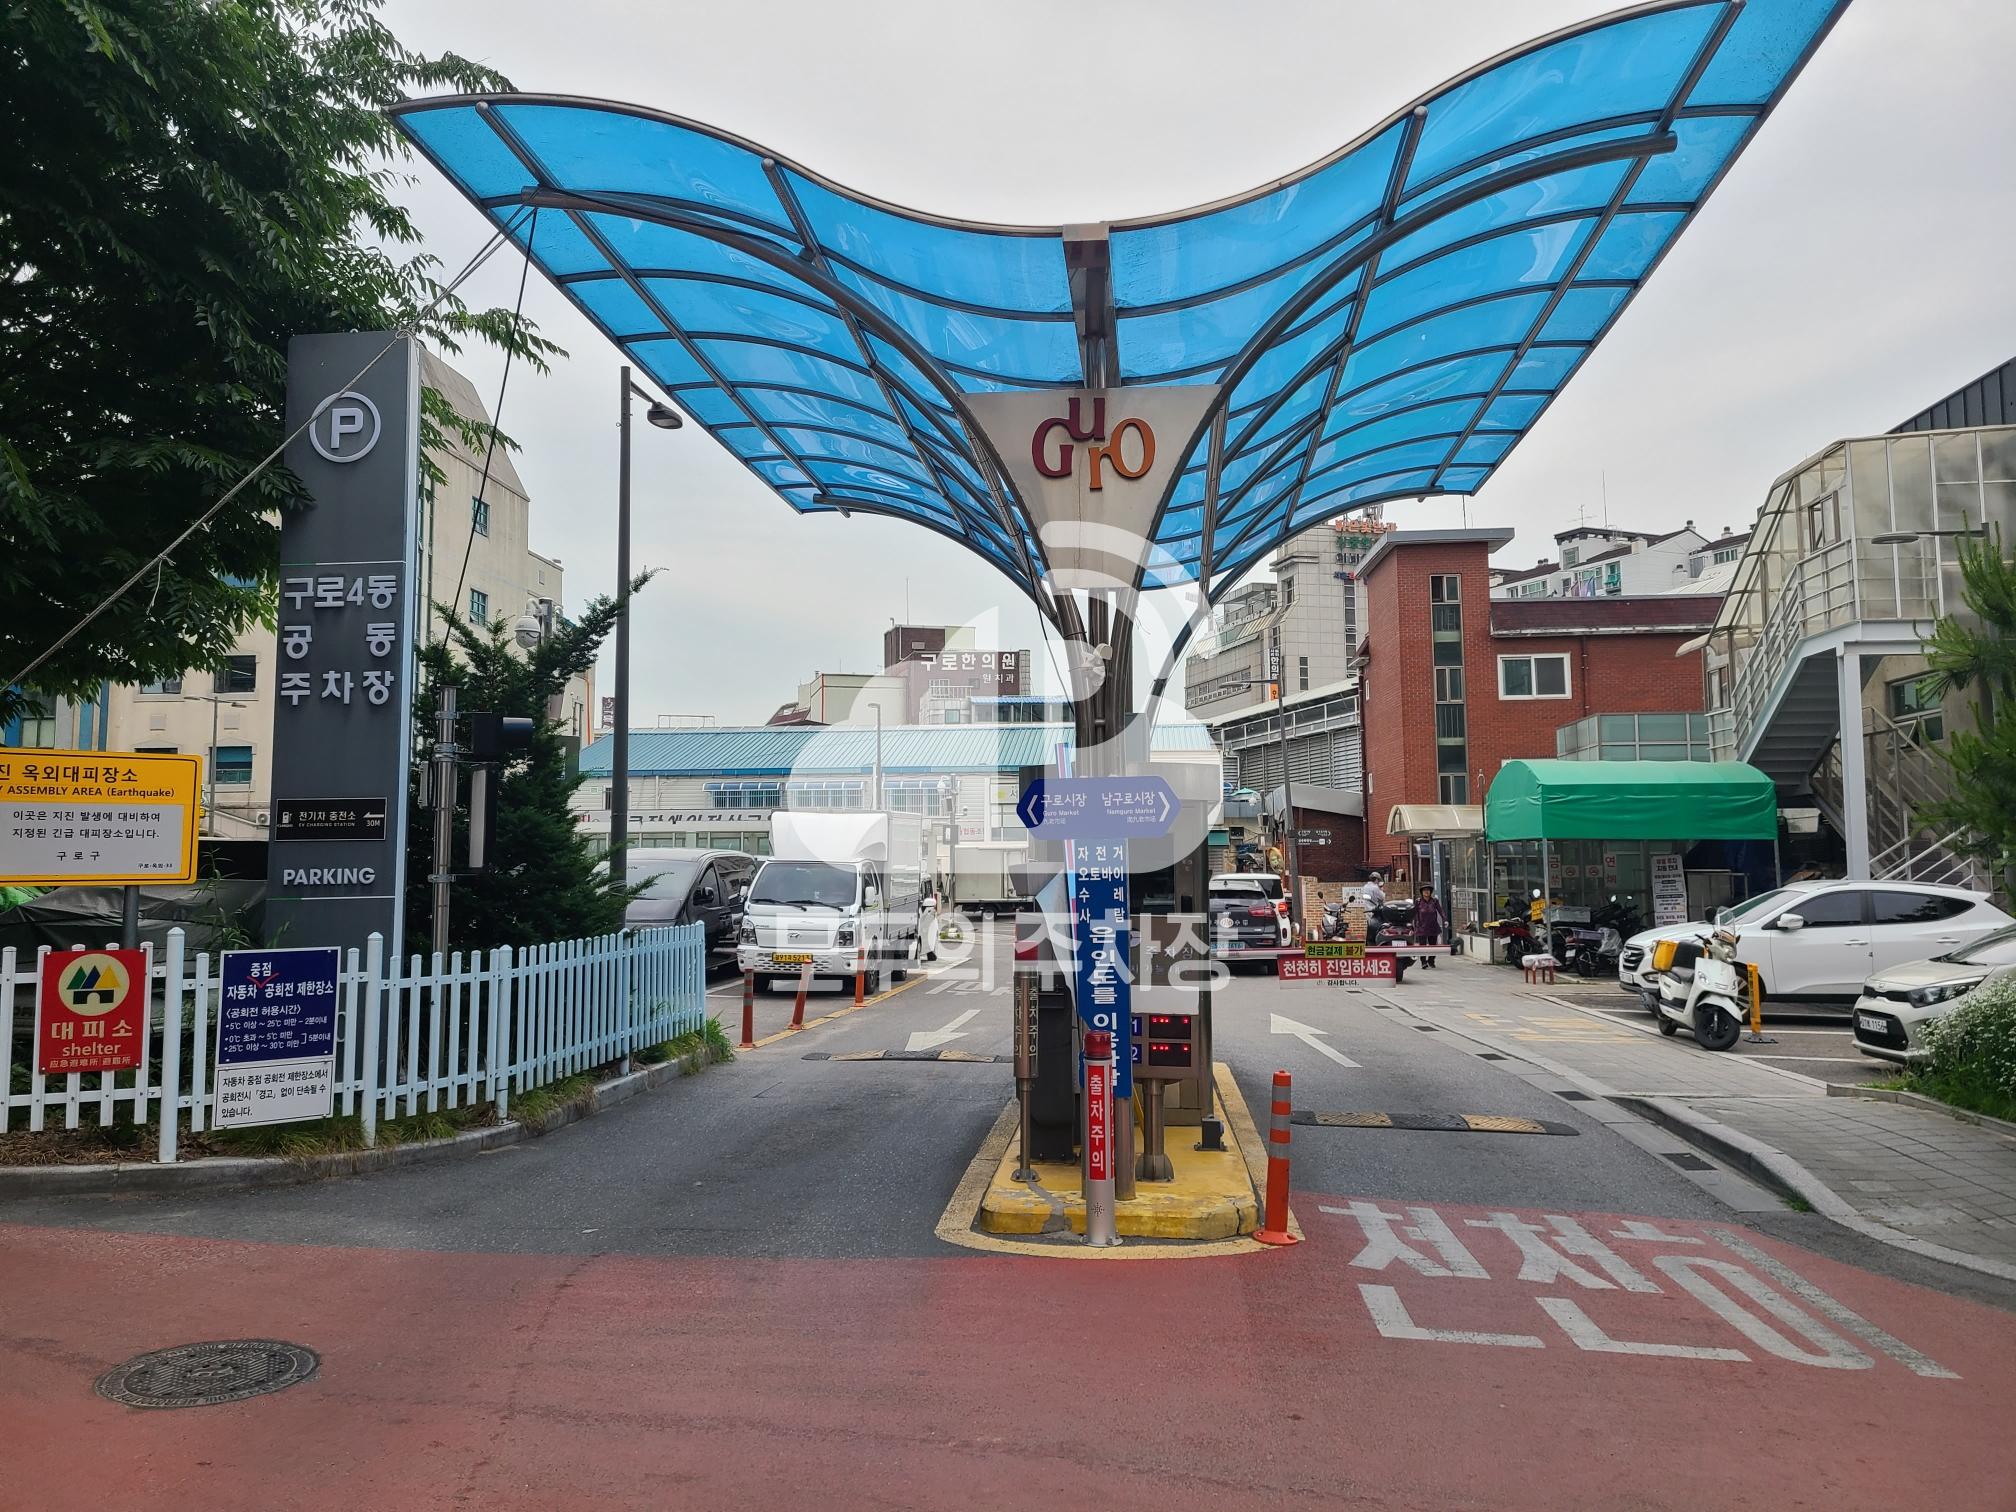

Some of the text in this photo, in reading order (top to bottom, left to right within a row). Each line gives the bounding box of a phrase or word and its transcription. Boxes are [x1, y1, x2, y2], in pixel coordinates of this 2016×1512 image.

[330, 407, 364, 449] P
[284, 575, 397, 610] 구로4동
[280, 671, 394, 705] 주차장
[22, 764, 139, 783] 옥외대피장소
[8, 786, 68, 796] ASSEMBLY
[72, 787, 102, 796] AREA
[107, 788, 175, 799] (Earthquake)
[1041, 792, 1155, 807] 구로시장 남구로시장
[13, 811, 161, 822] 이곳은 지진 발생에 대비하여
[299, 811, 356, 821] 전기차 충전소
[12, 828, 160, 839] 지정된 긴급 대피장소입니다.
[1078, 845, 1124, 862] 자전거
[283, 867, 376, 886] PARKING
[1078, 865, 1124, 882] 오토바이
[1307, 945, 1363, 956] 현금결제 불가
[250, 962, 272, 977] 중점
[1283, 959, 1392, 976] 천천히 진입하세요
[227, 980, 334, 1000] 자동차 공회전 제한장소
[51, 1020, 133, 1040] 대피소
[243, 1020, 257, 1029] 이상
[283, 1018, 297, 1027] 미만
[280, 1031, 293, 1040] 미만
[62, 1042, 121, 1057] shelter
[246, 1042, 259, 1051] 이상
[286, 1039, 300, 1049] 미만
[223, 1069, 328, 1087] 자동차 중점 공회전 제한장소에서
[221, 1091, 252, 1103] 공회전시
[280, 1086, 295, 1097] 없이
[296, 1084, 317, 1096] 단속될
[319, 1084, 327, 1094] 수
[221, 1106, 253, 1119] 있습니다.
[1089, 1073, 1105, 1173] 출차주의
